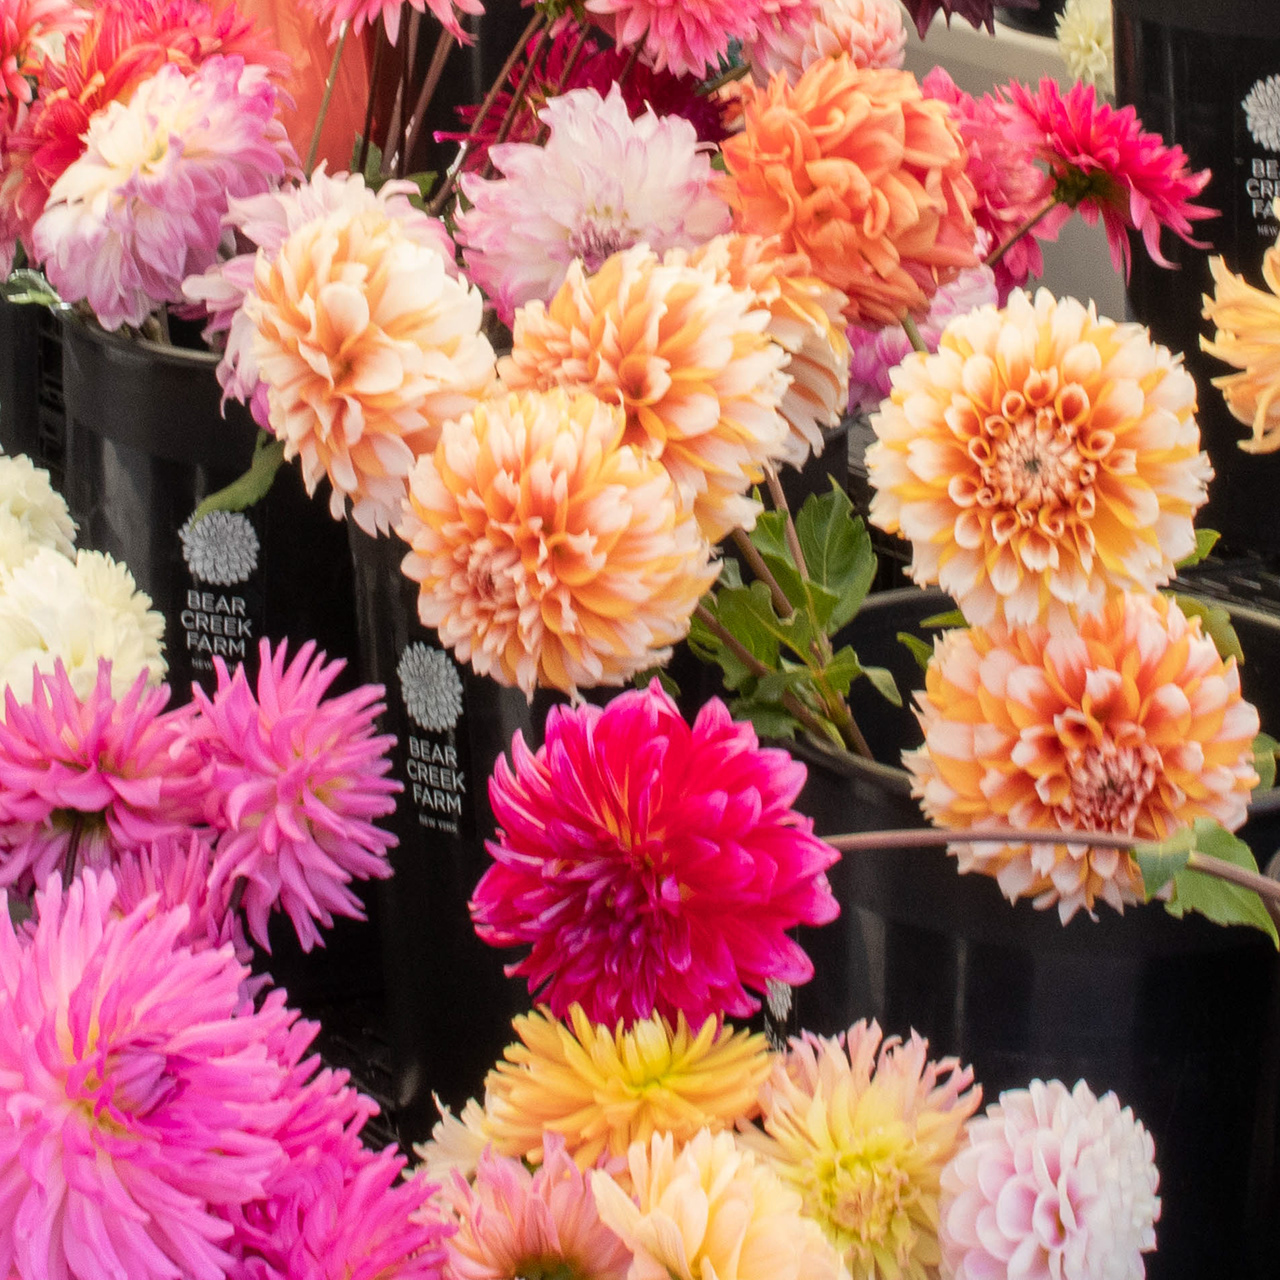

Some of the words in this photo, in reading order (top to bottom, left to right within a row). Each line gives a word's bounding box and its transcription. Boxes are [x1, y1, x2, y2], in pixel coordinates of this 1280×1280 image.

[1257, 224, 1279, 236] NEW
[187, 589, 246, 617] BEAR
[181, 609, 253, 638] CREEK
[187, 631, 245, 658] FARM
[191, 657, 213, 671] NEW
[409, 735, 458, 768] BEAR
[406, 758, 466, 793] CREEK
[413, 782, 462, 816] FARM
